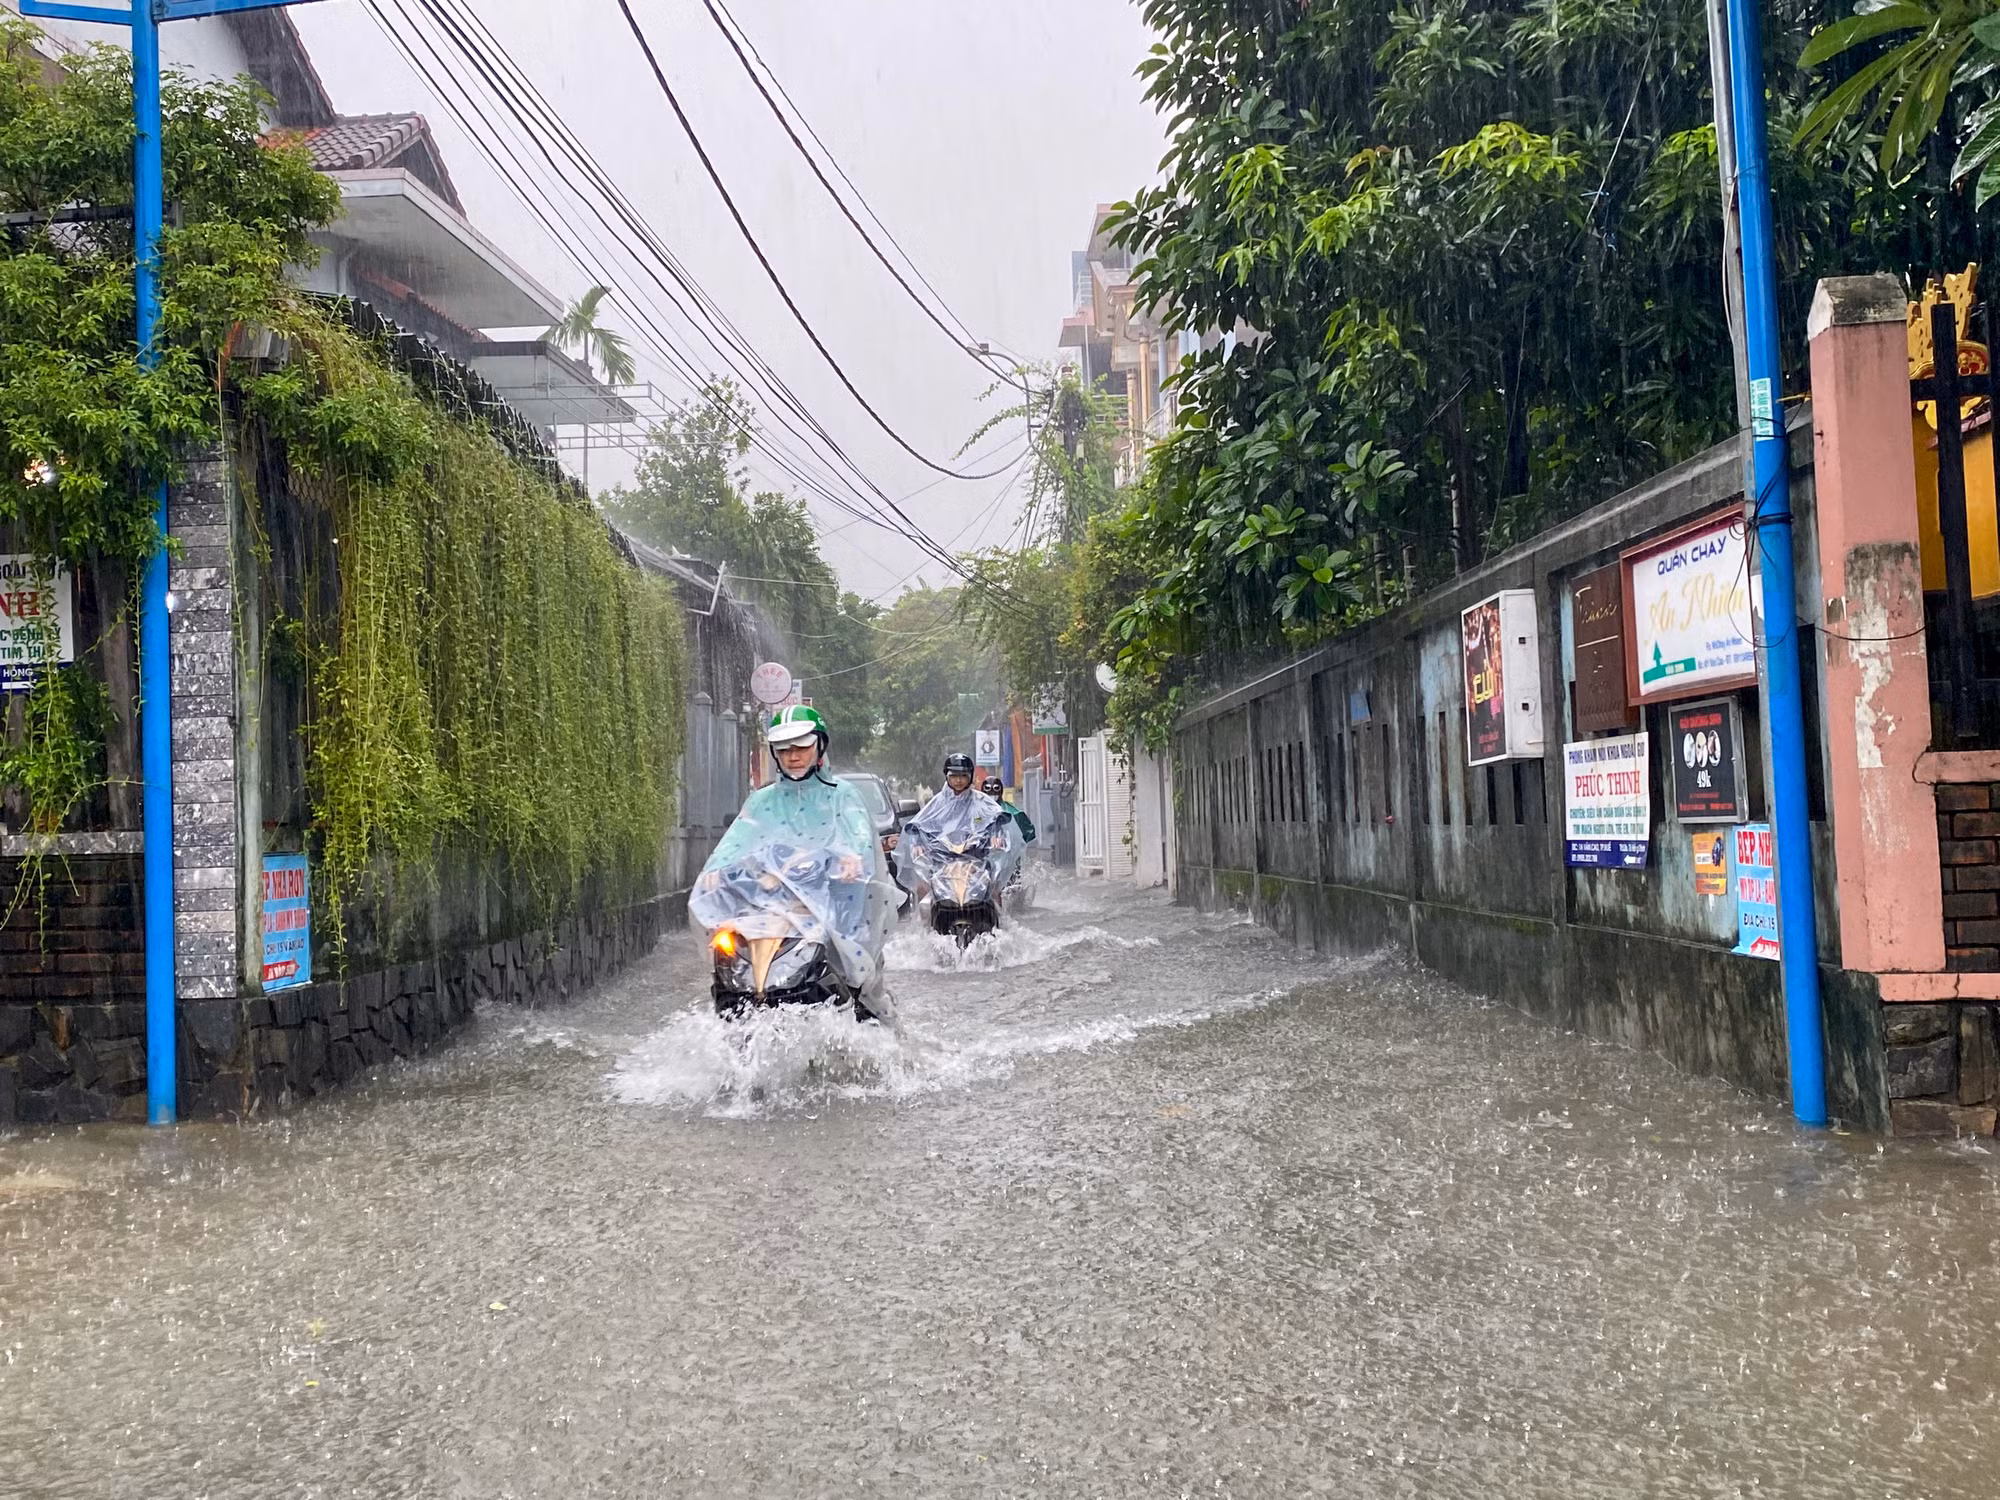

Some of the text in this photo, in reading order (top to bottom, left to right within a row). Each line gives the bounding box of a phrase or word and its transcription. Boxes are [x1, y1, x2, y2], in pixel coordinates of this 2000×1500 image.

[1657, 536, 1727, 575] QUÁN CHAY
[1575, 768, 1640, 800] PHÚC THỊNH
[1697, 769, 1711, 787] 49k
